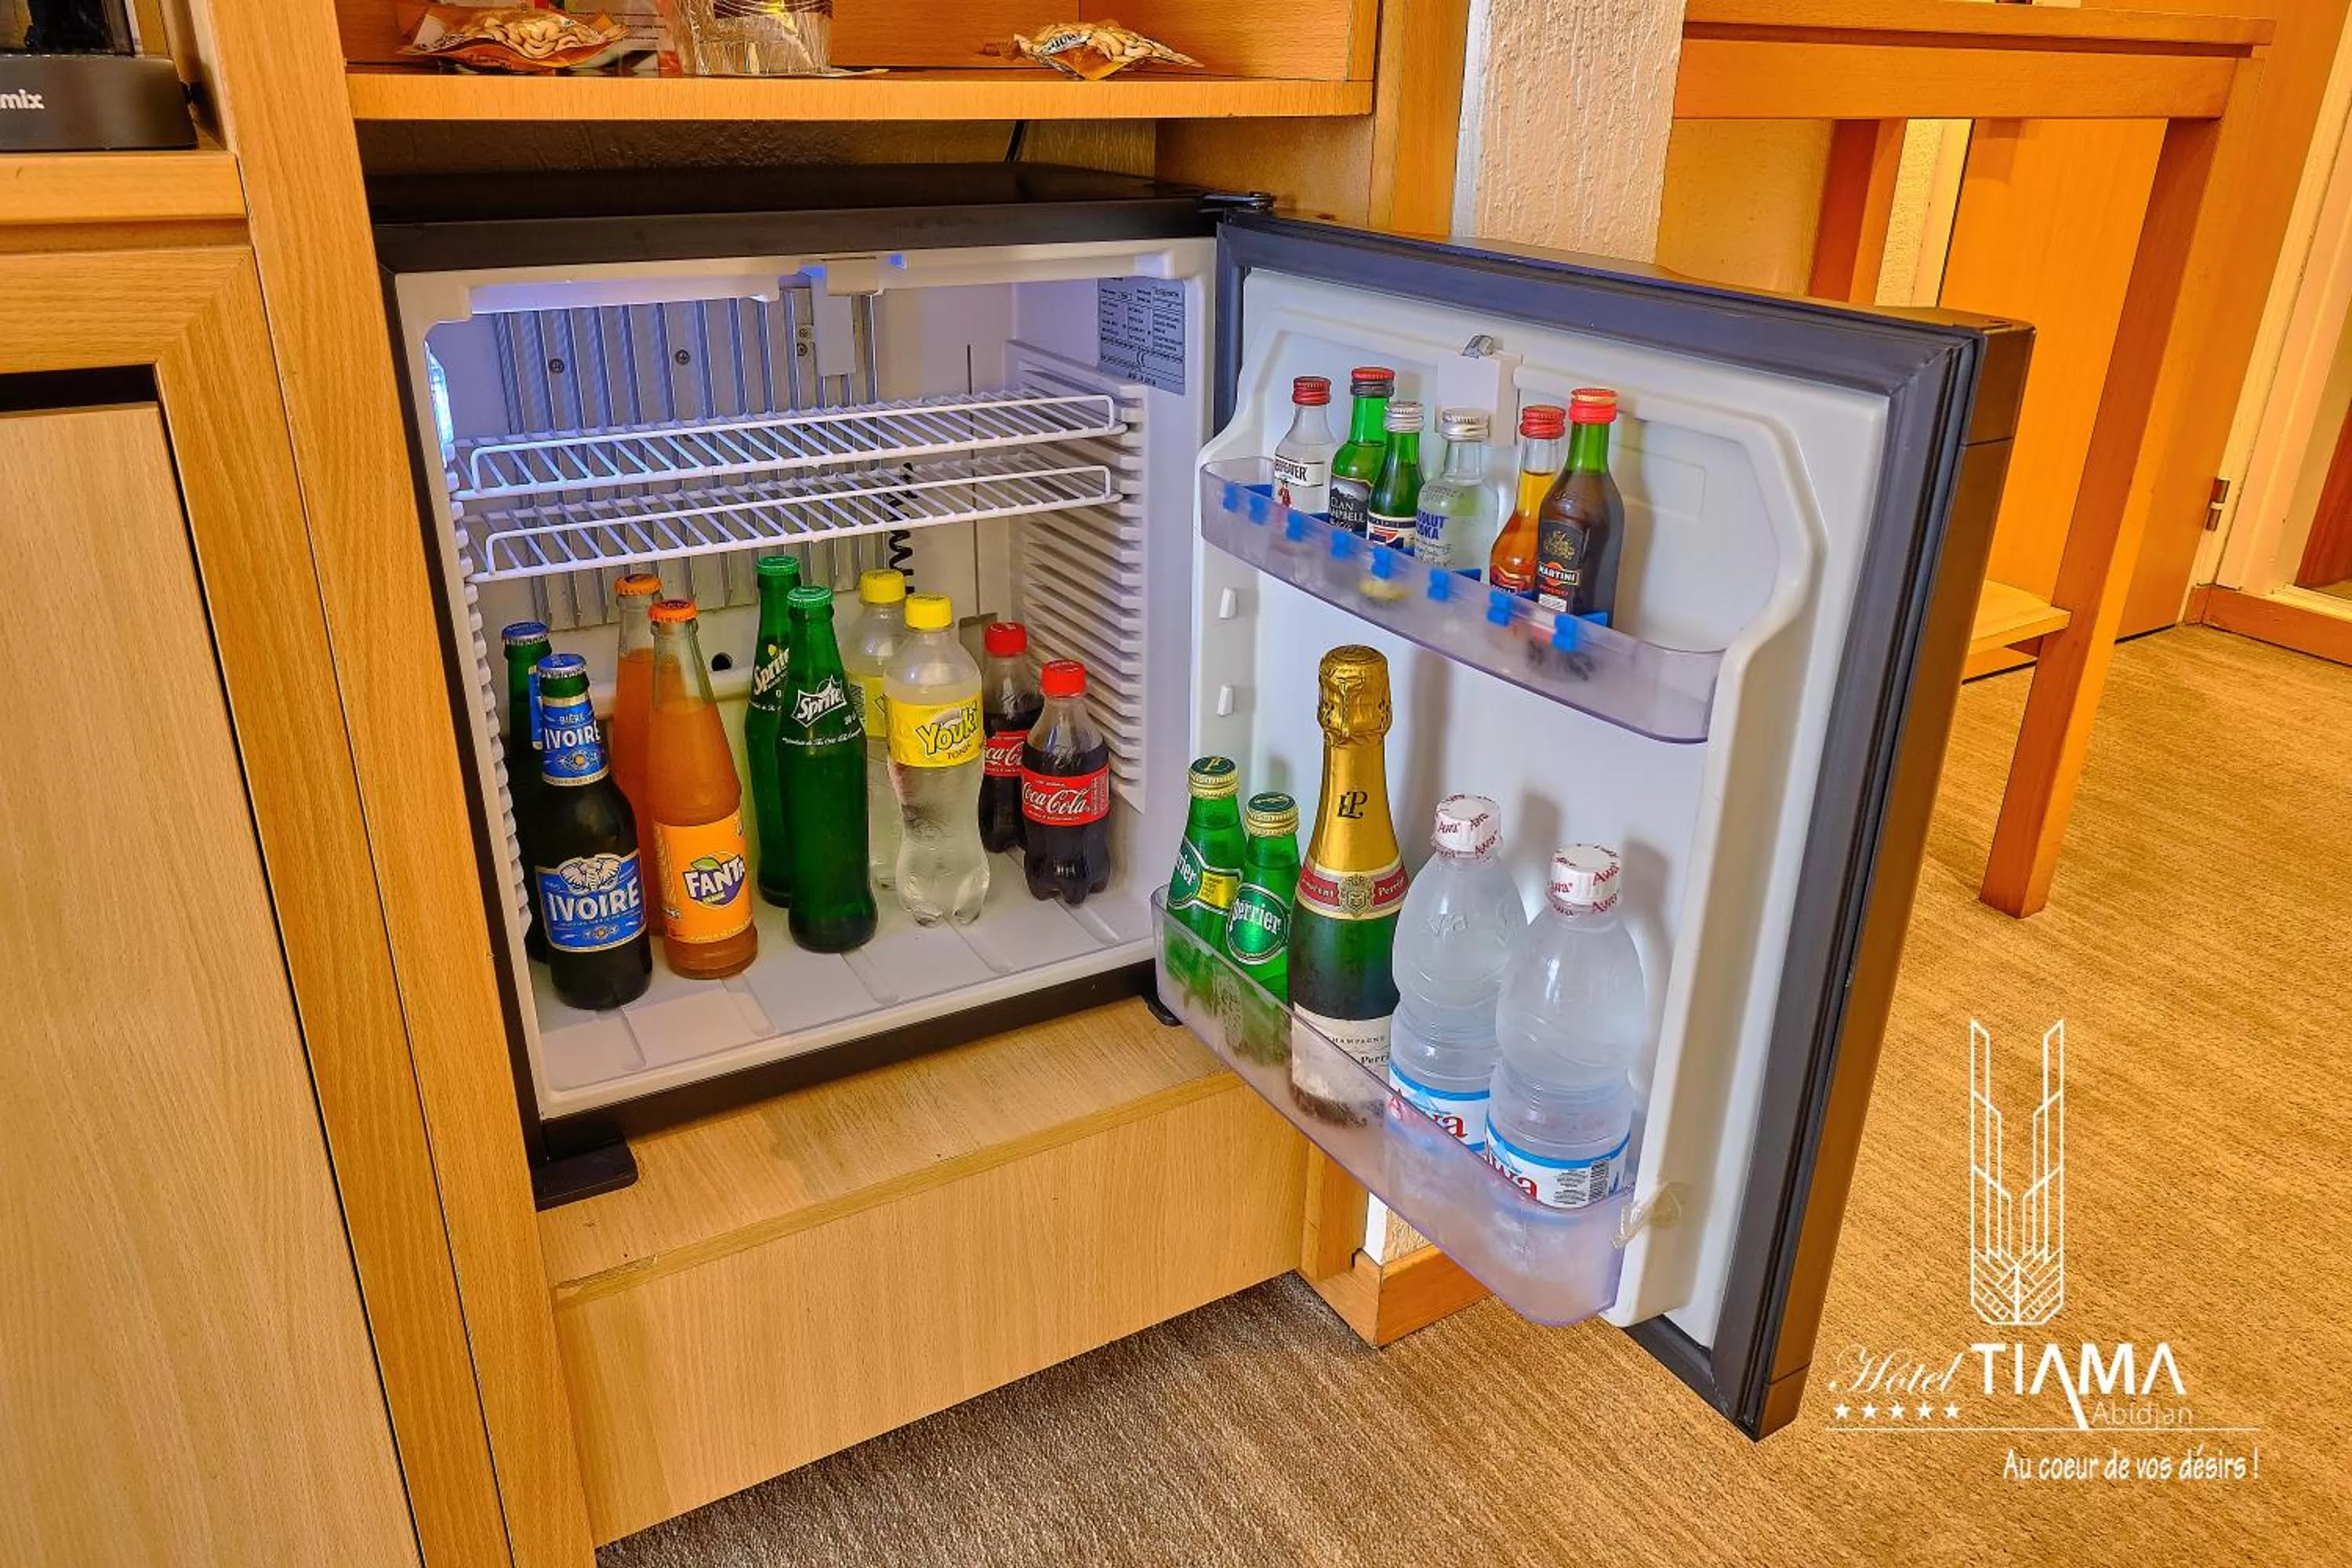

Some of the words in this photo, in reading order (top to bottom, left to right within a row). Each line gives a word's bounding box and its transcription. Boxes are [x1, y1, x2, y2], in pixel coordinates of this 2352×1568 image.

[0, 89, 45, 109] mix
[1539, 564, 1576, 582] MARTINI
[797, 685, 845, 722] Sprite
[916, 699, 978, 756] Youki
[546, 876, 641, 922] IVOIRE
[1229, 898, 1283, 935] Perrier
